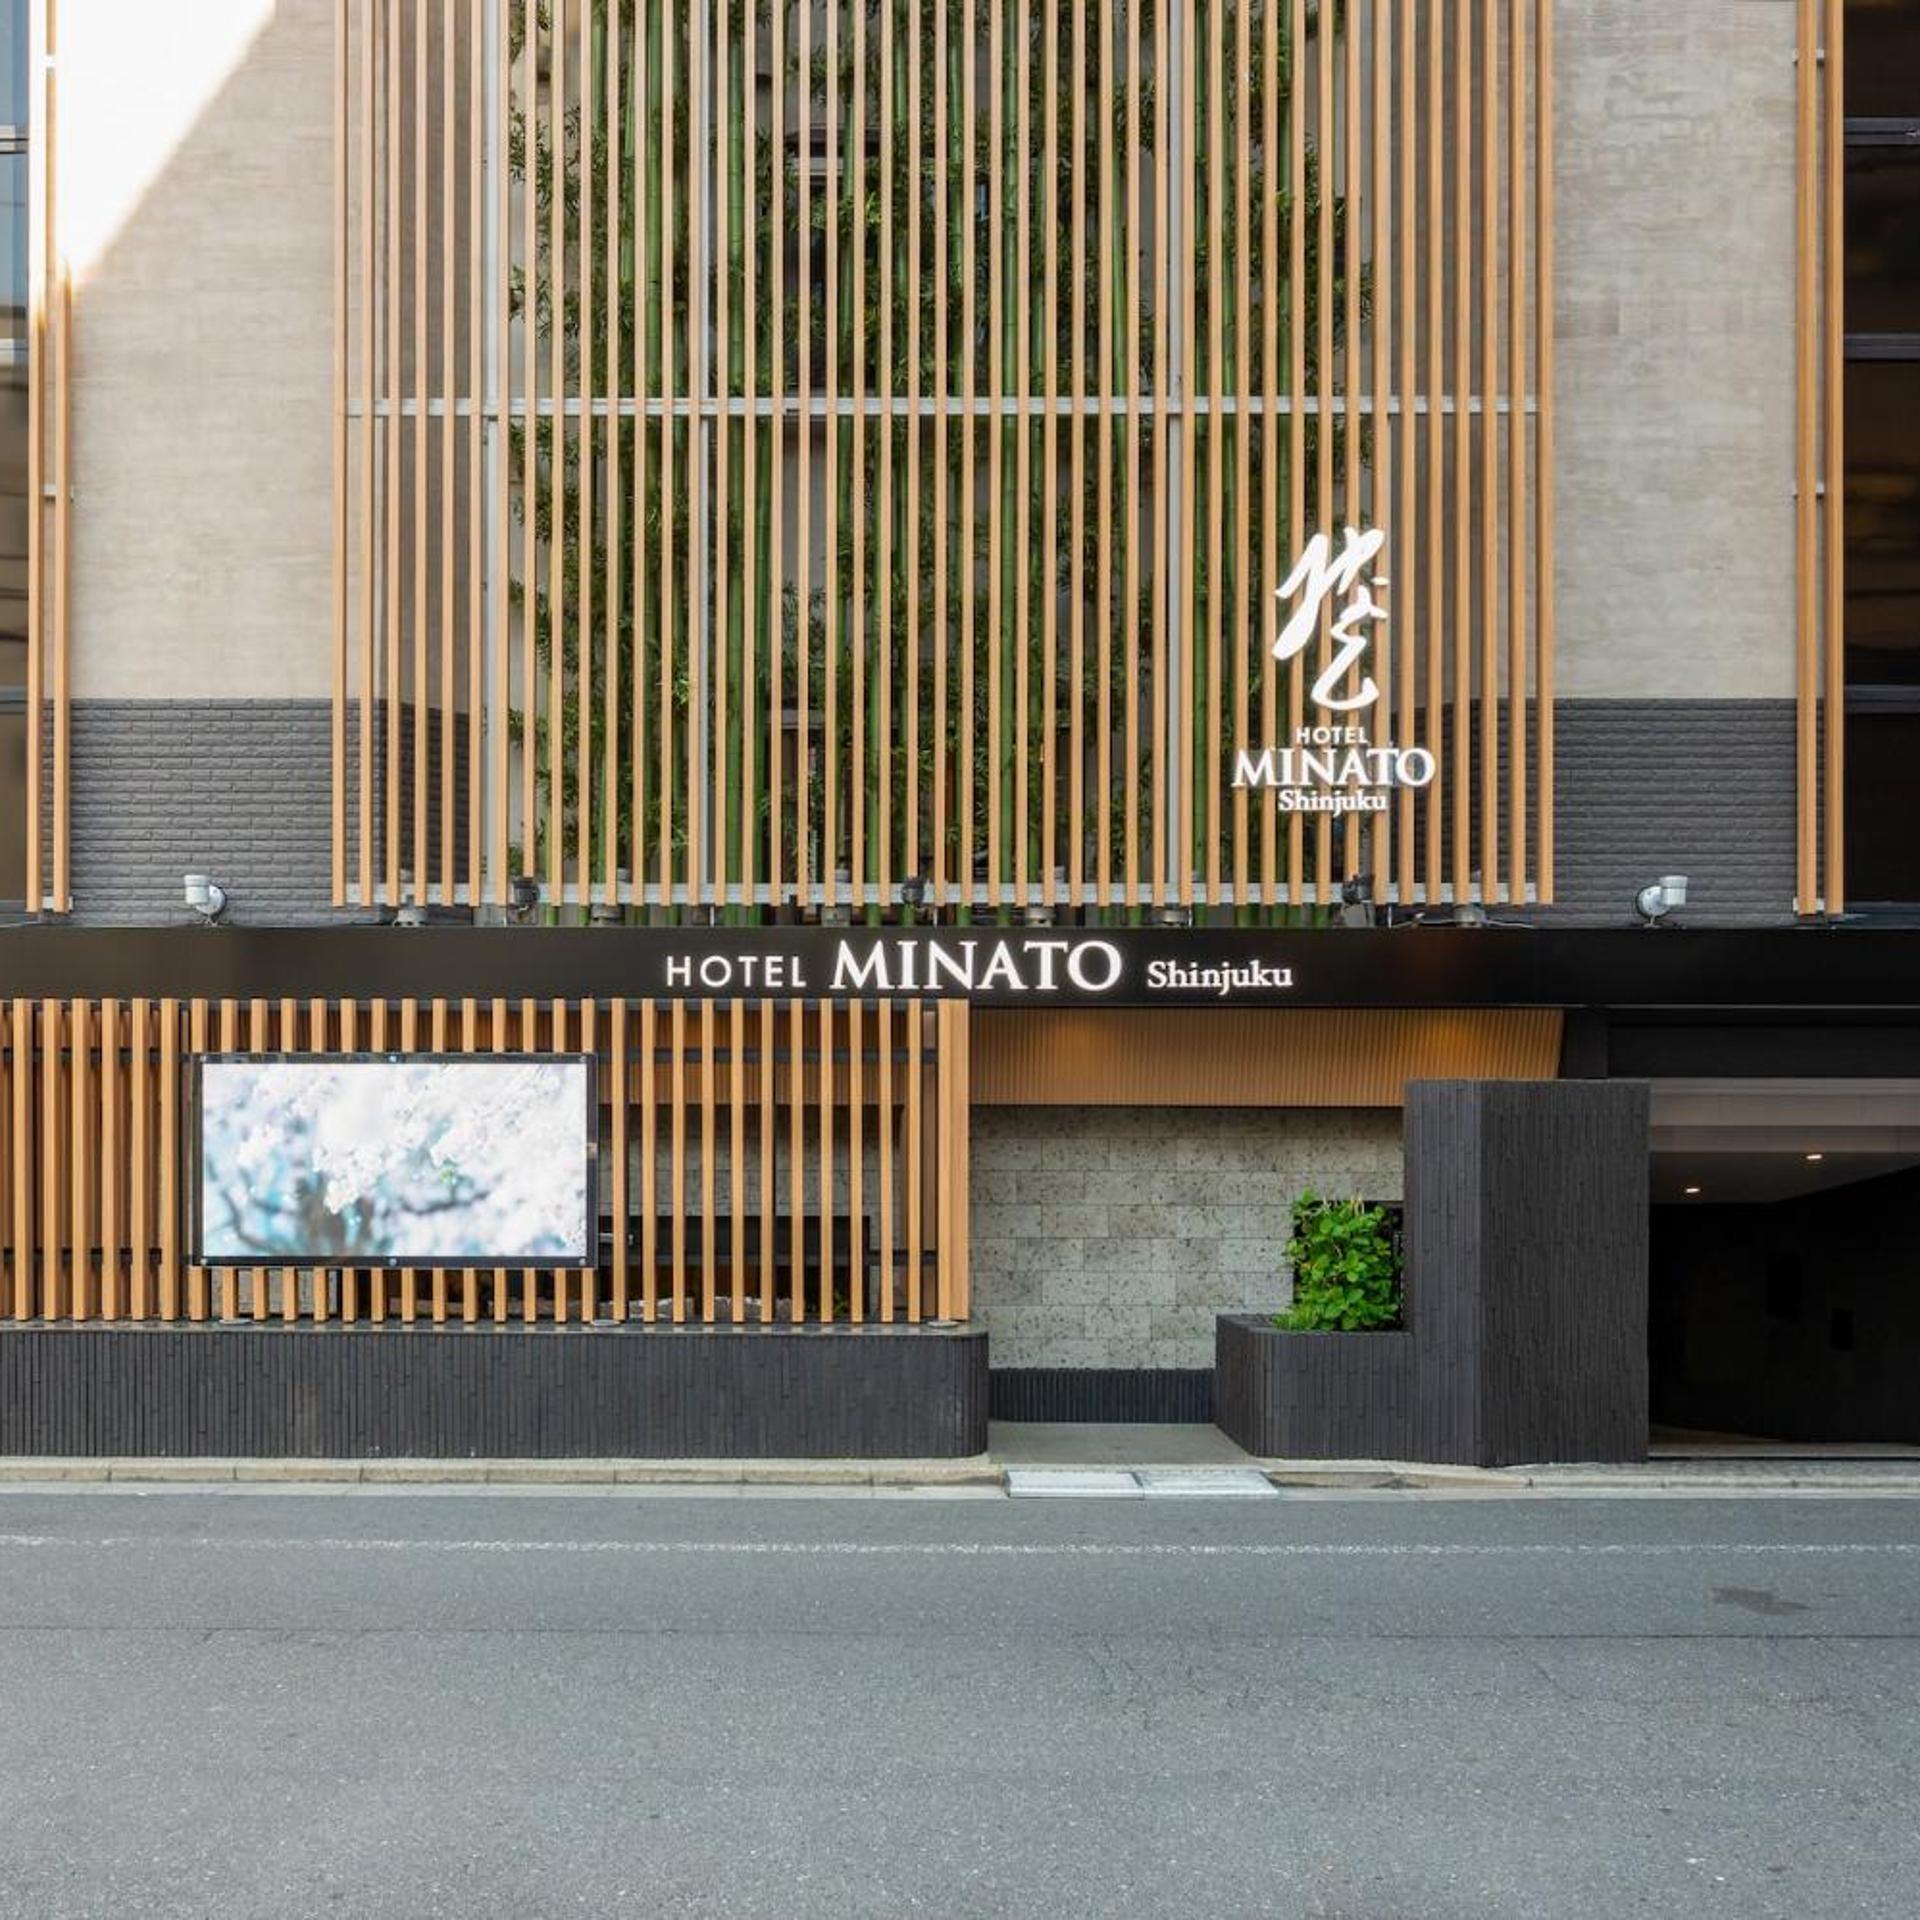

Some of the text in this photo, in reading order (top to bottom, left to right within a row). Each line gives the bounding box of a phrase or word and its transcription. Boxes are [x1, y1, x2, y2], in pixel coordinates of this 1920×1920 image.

[1295, 726, 1368, 744] HOTEL
[1231, 746, 1436, 787] MINATO
[1278, 788, 1388, 817] Shinjuku
[665, 939, 1294, 996] HOTEL MINATO Shinjuku
